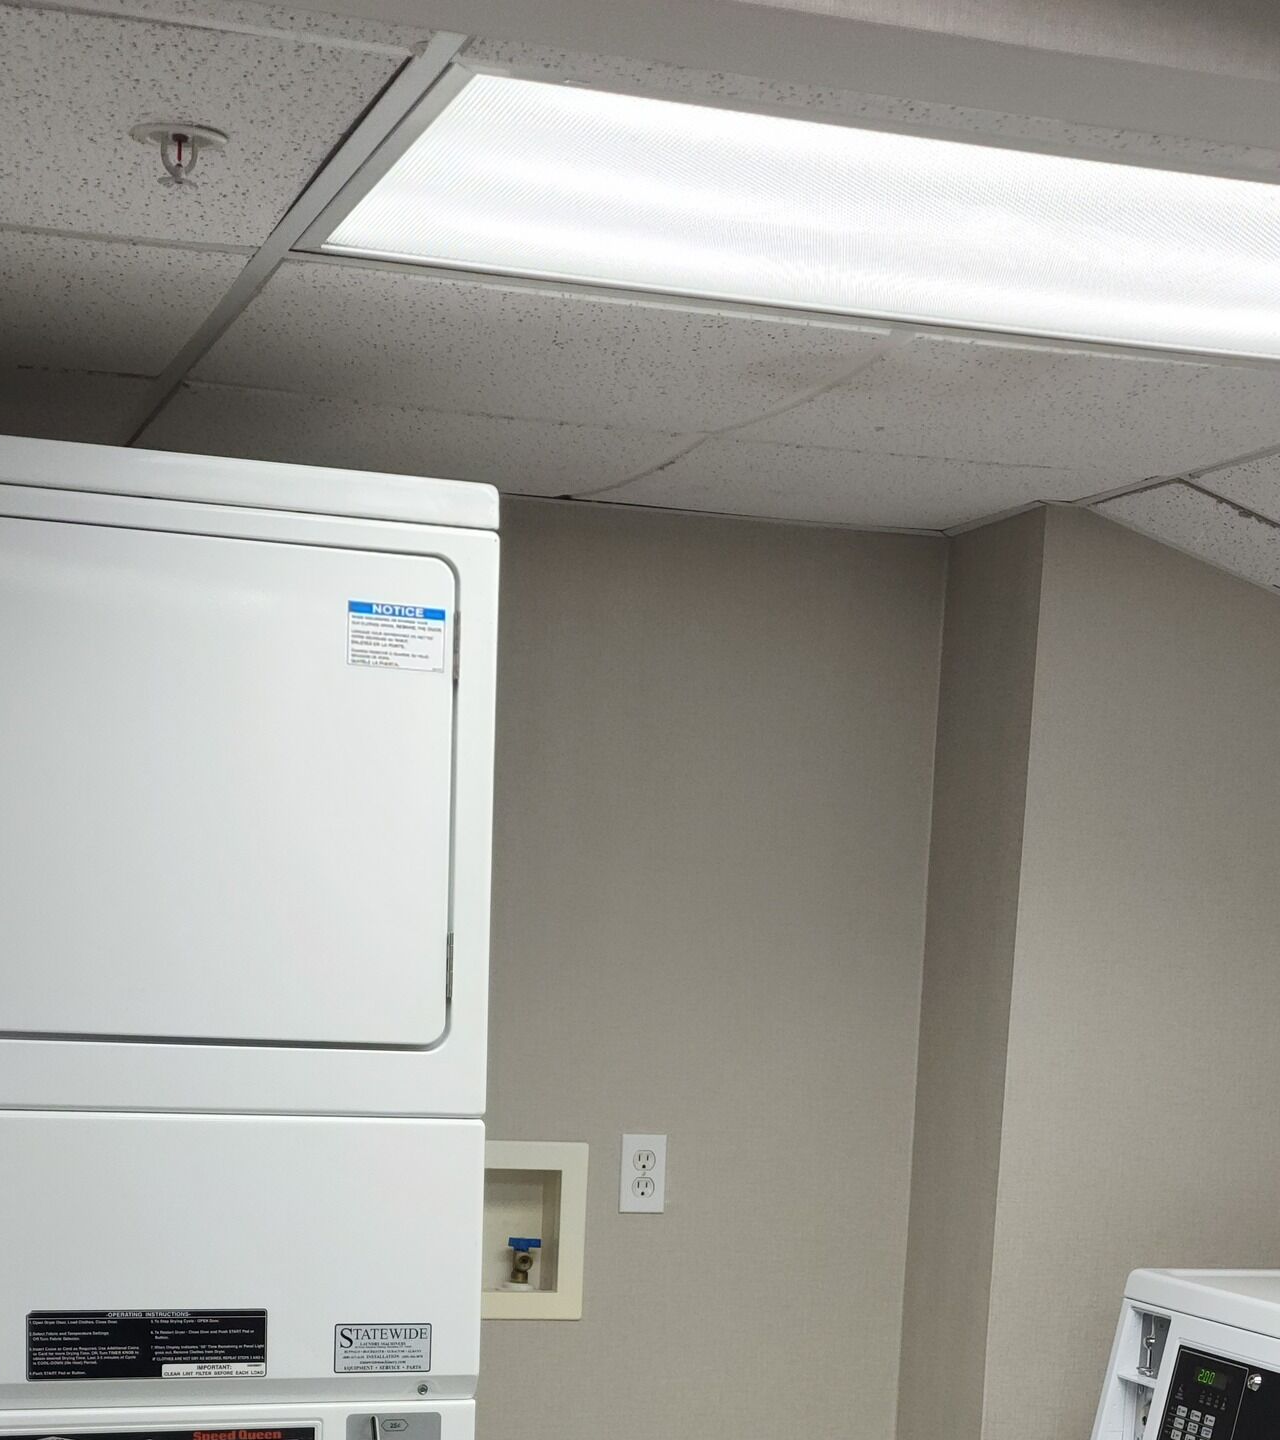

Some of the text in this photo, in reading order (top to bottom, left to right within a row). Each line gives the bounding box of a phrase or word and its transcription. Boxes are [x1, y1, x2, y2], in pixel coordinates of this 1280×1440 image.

[372, 604, 424, 617] NOTICE
[340, 1328, 428, 1349] STATEWIDE
[239, 1430, 282, 1439] Queen
